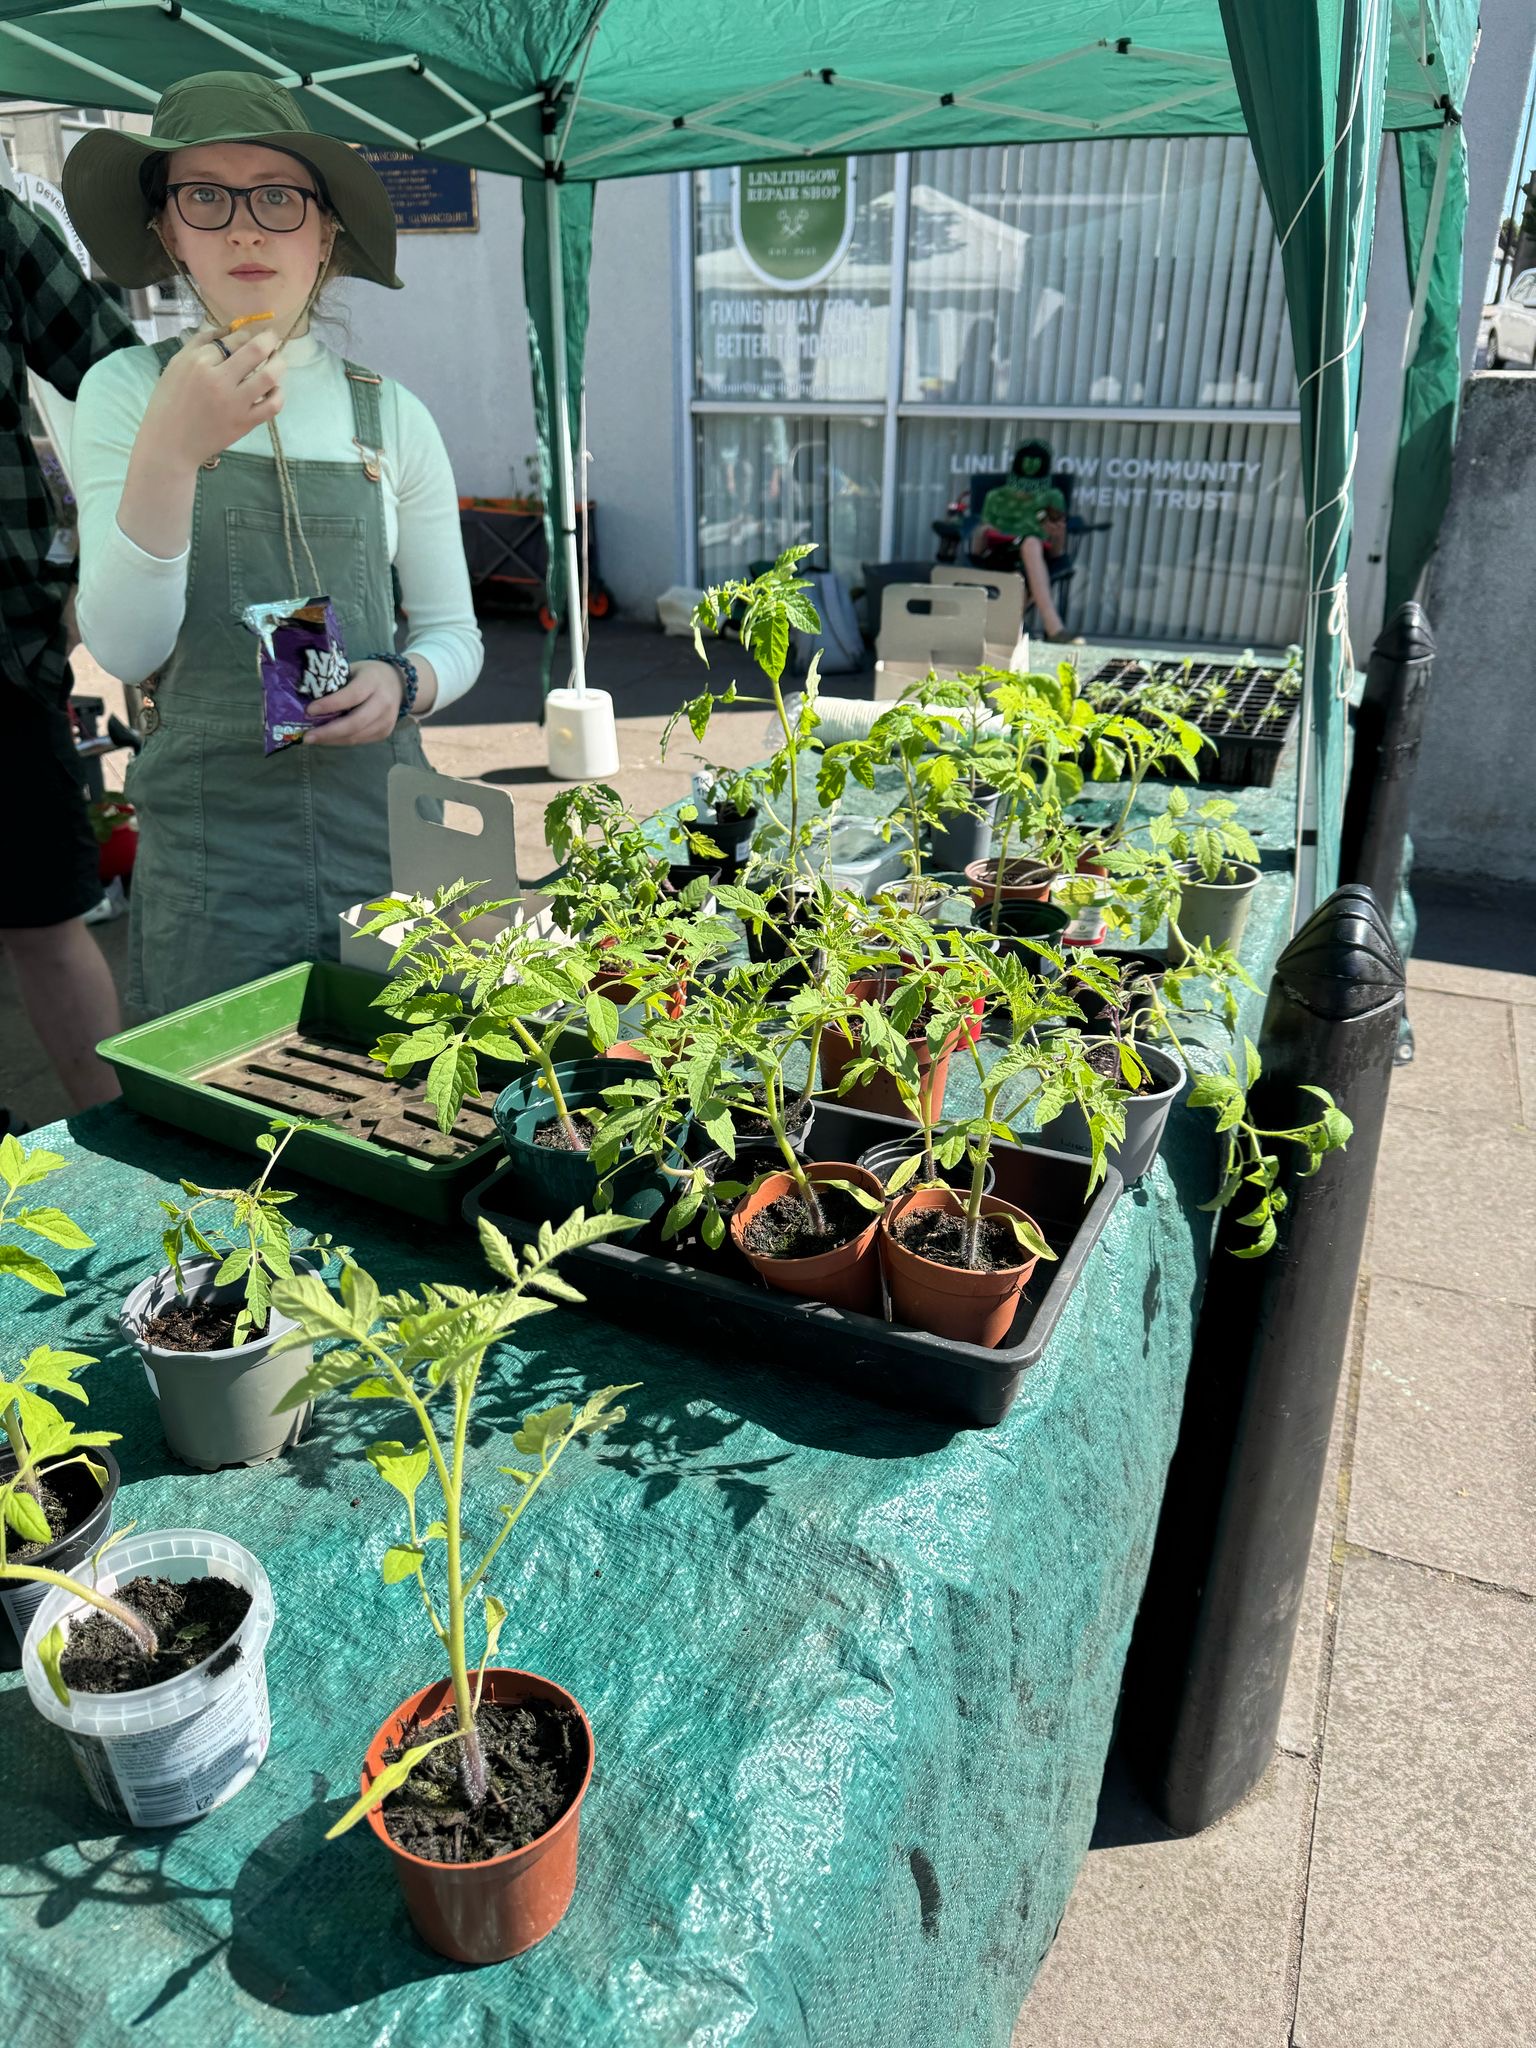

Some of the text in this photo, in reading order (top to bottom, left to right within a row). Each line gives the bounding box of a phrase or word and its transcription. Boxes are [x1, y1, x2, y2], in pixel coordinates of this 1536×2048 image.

[748, 168, 840, 186] LINLITHGOW
[747, 185, 841, 202] REPAIR SHOP
[710, 299, 762, 325] FIXING
[766, 298, 820, 325] TODAY
[716, 332, 770, 359] BETTER
[951, 454, 1262, 482] LINLIOW COMMUNITY
[1153, 489, 1235, 511] TRUST
